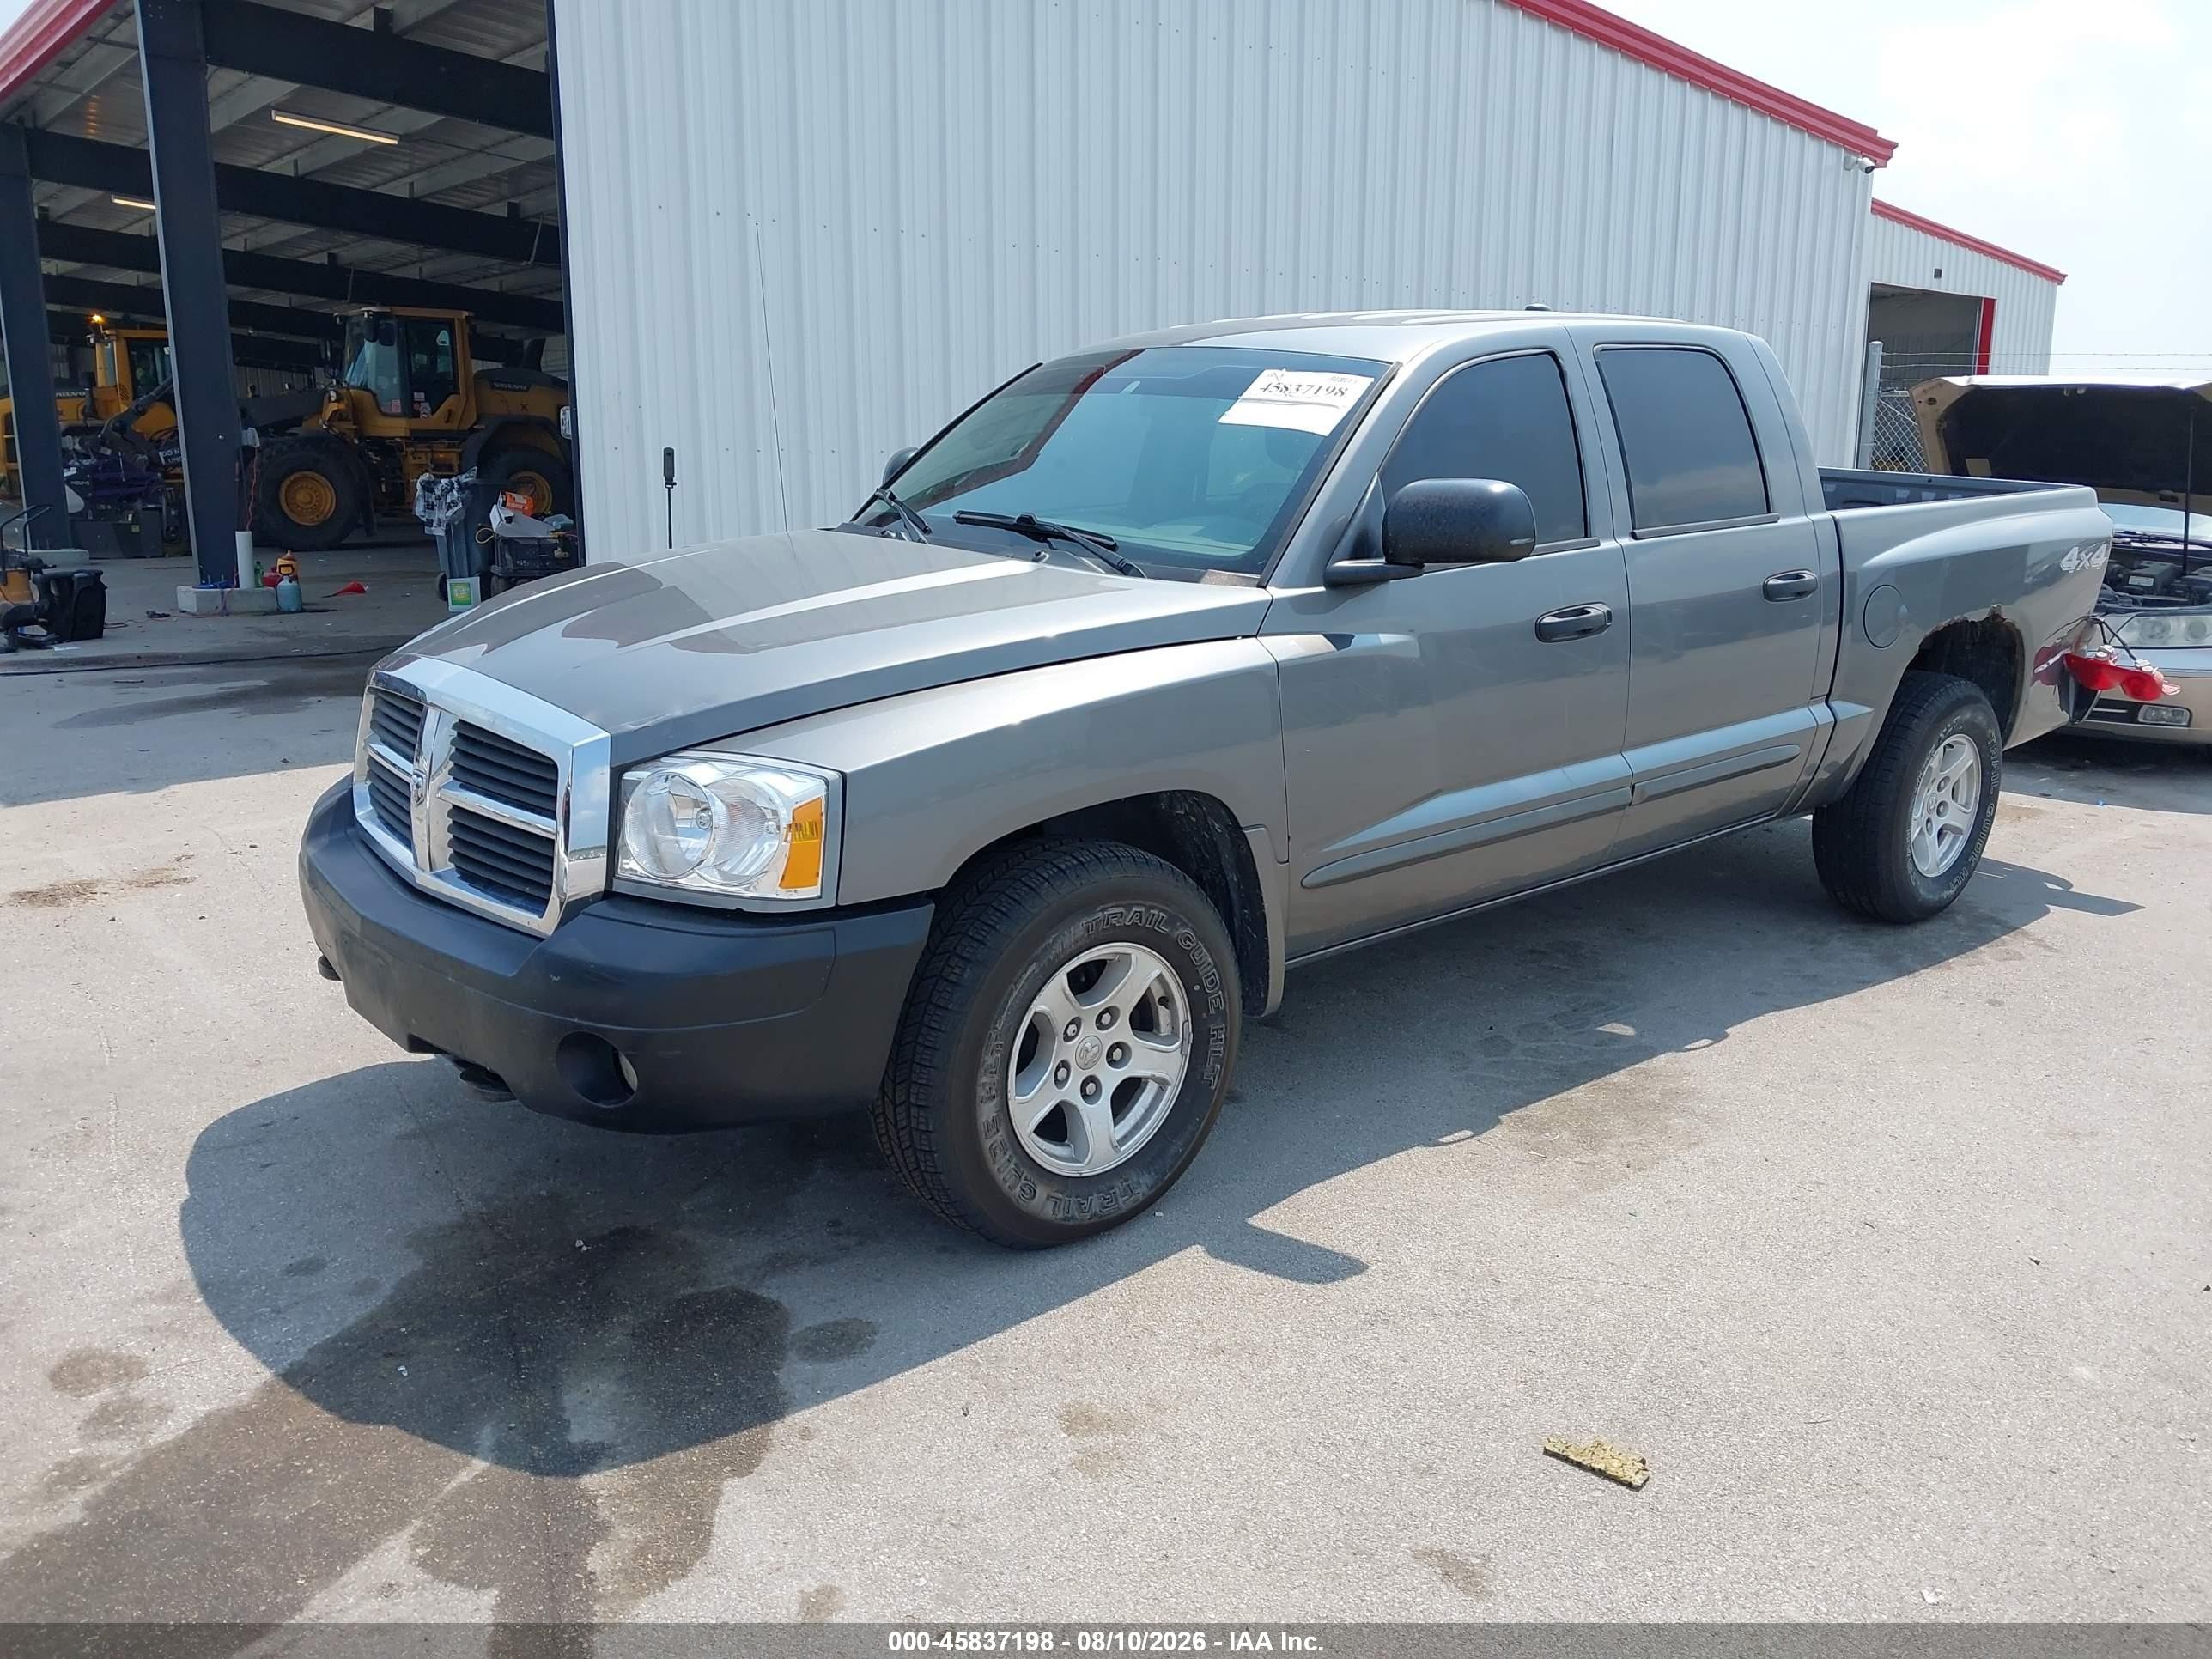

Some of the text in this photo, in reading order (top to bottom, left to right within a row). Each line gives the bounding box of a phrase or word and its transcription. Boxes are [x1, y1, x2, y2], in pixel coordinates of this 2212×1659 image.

[1260, 381, 1348, 398] 45837198
[1081, 905, 1226, 1091] TRAIL GUIDE HLT
[981, 1115, 1038, 1202] GUIDE
[1046, 1180, 1141, 1224] TRAIL
